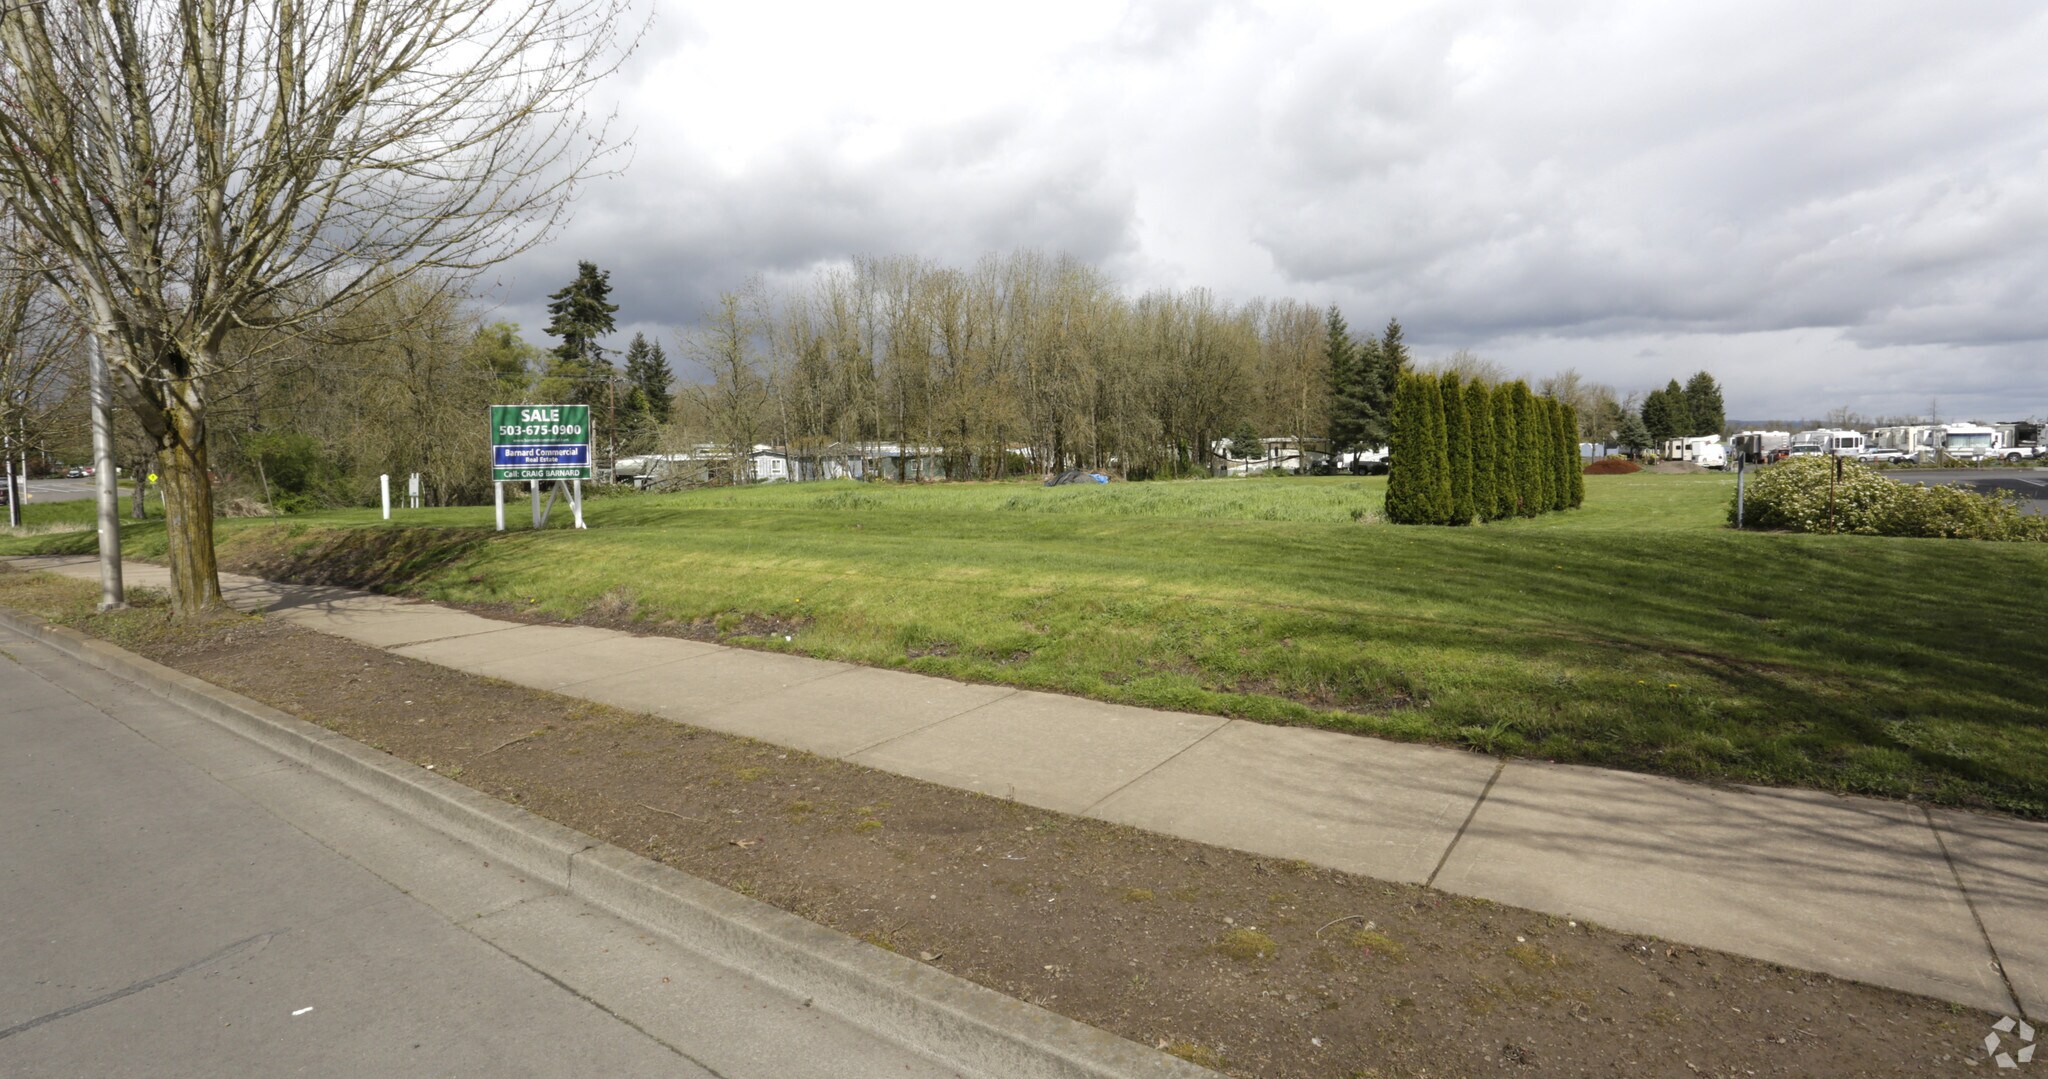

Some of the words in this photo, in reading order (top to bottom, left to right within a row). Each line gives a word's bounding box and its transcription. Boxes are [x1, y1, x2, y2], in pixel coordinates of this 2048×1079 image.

[521, 409, 559, 422] SALE
[499, 425, 581, 435] 503-675-0900
[505, 448, 534, 456] Barnard
[536, 448, 578, 456] Commercial
